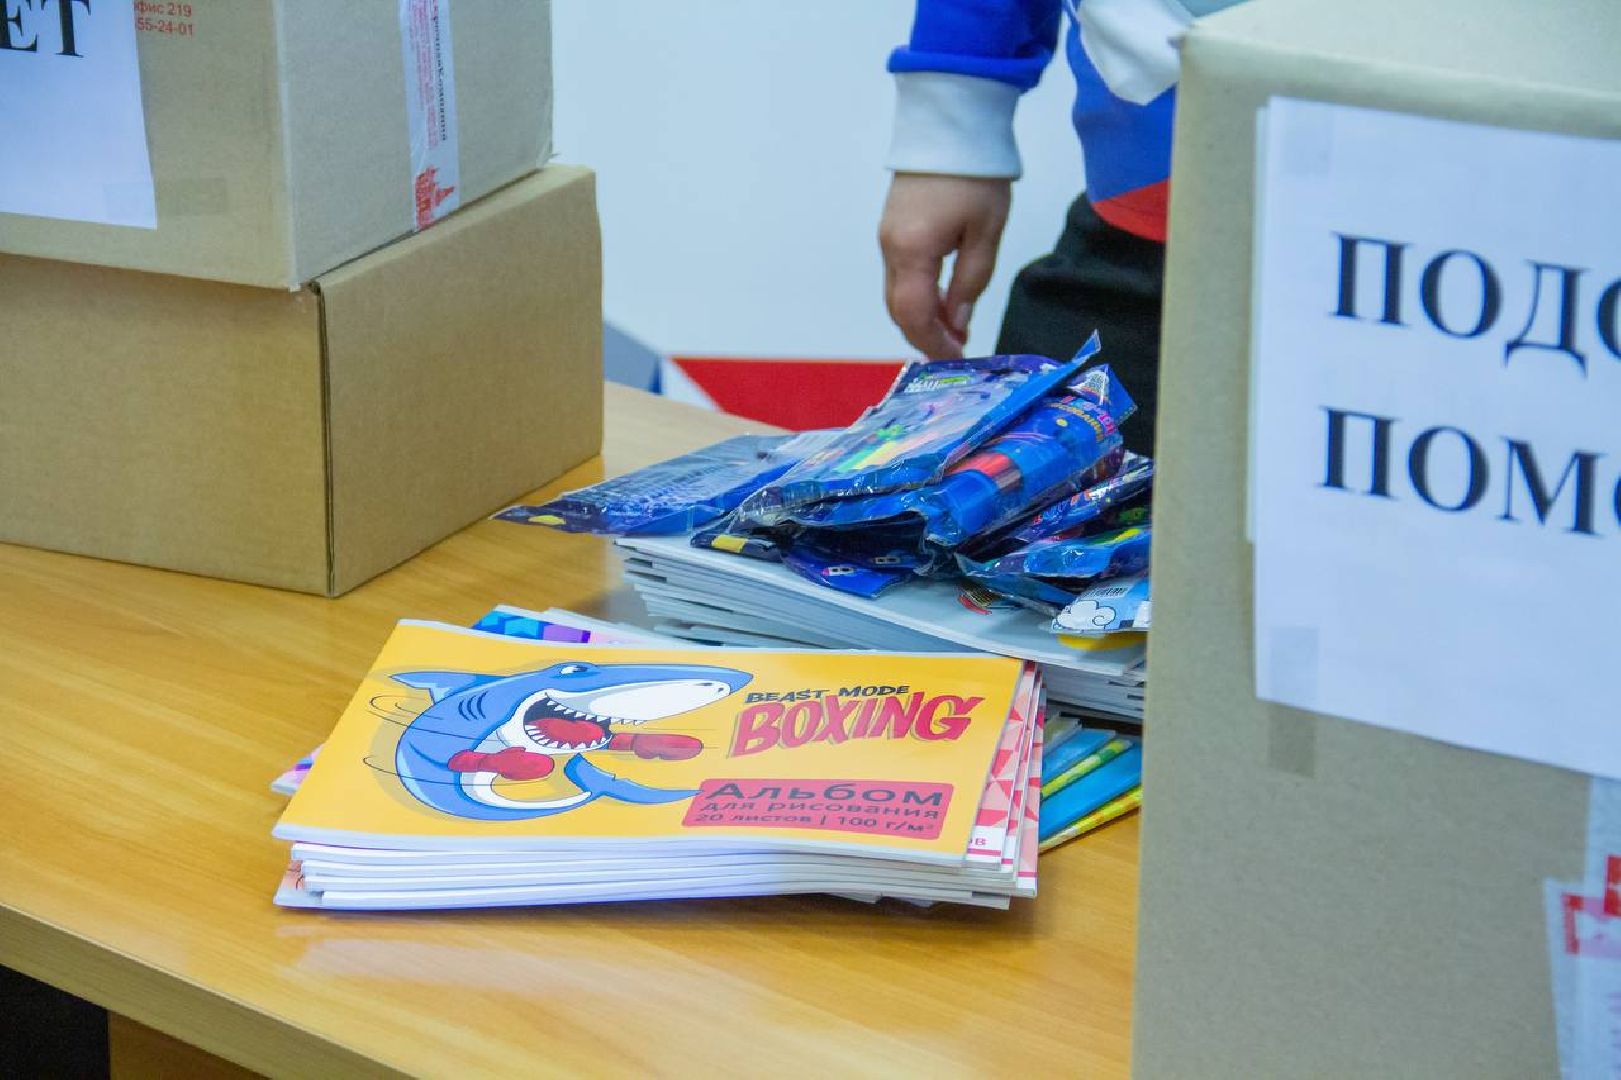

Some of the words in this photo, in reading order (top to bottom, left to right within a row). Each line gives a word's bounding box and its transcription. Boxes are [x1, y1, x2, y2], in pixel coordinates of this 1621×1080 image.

[134, 0, 164, 14] фис
[167, 2, 192, 17] 219
[1328, 229, 1621, 378] ПОД
[1314, 404, 1621, 537] ПОМ
[745, 688, 830, 704] BEAST
[838, 685, 910, 698] MODE
[727, 691, 986, 759] BOXING
[705, 782, 943, 807] Альбом
[695, 813, 723, 822] 20
[729, 814, 812, 823] листов
[837, 816, 877, 828] 100
[700, 801, 755, 812] для
[767, 802, 940, 820] рисования
